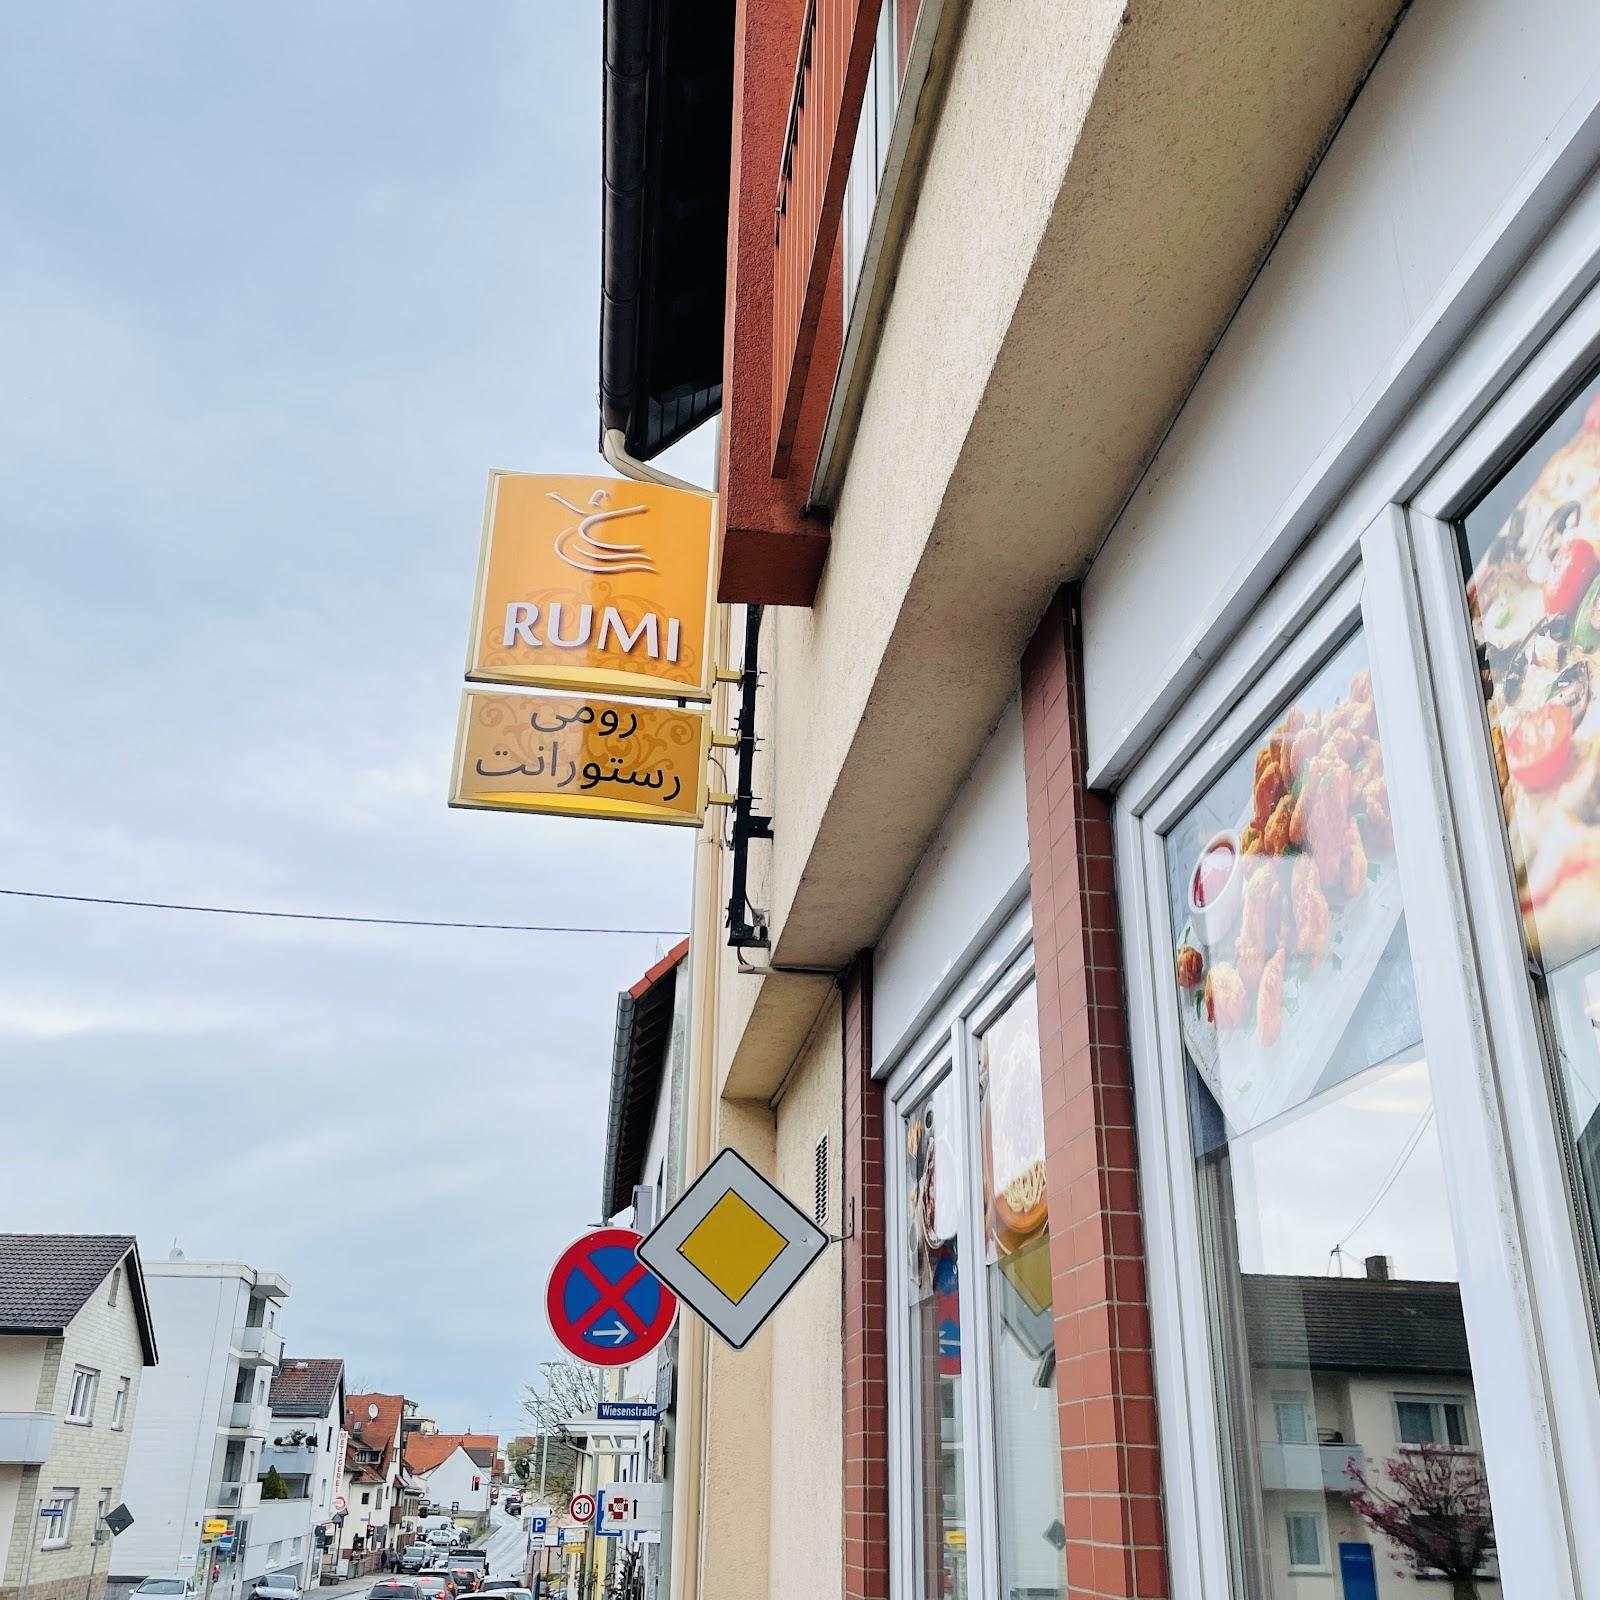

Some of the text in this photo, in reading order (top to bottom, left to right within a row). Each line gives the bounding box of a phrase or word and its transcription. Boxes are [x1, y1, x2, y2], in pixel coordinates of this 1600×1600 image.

[503, 602, 680, 662] RUMI
[475, 741, 681, 801] رستورانت
[602, 1404, 657, 1417] Wiesenstraße
[335, 1432, 347, 1493] METZGEREI
[535, 1519, 544, 1532] P
[575, 1502, 590, 1515] 30
